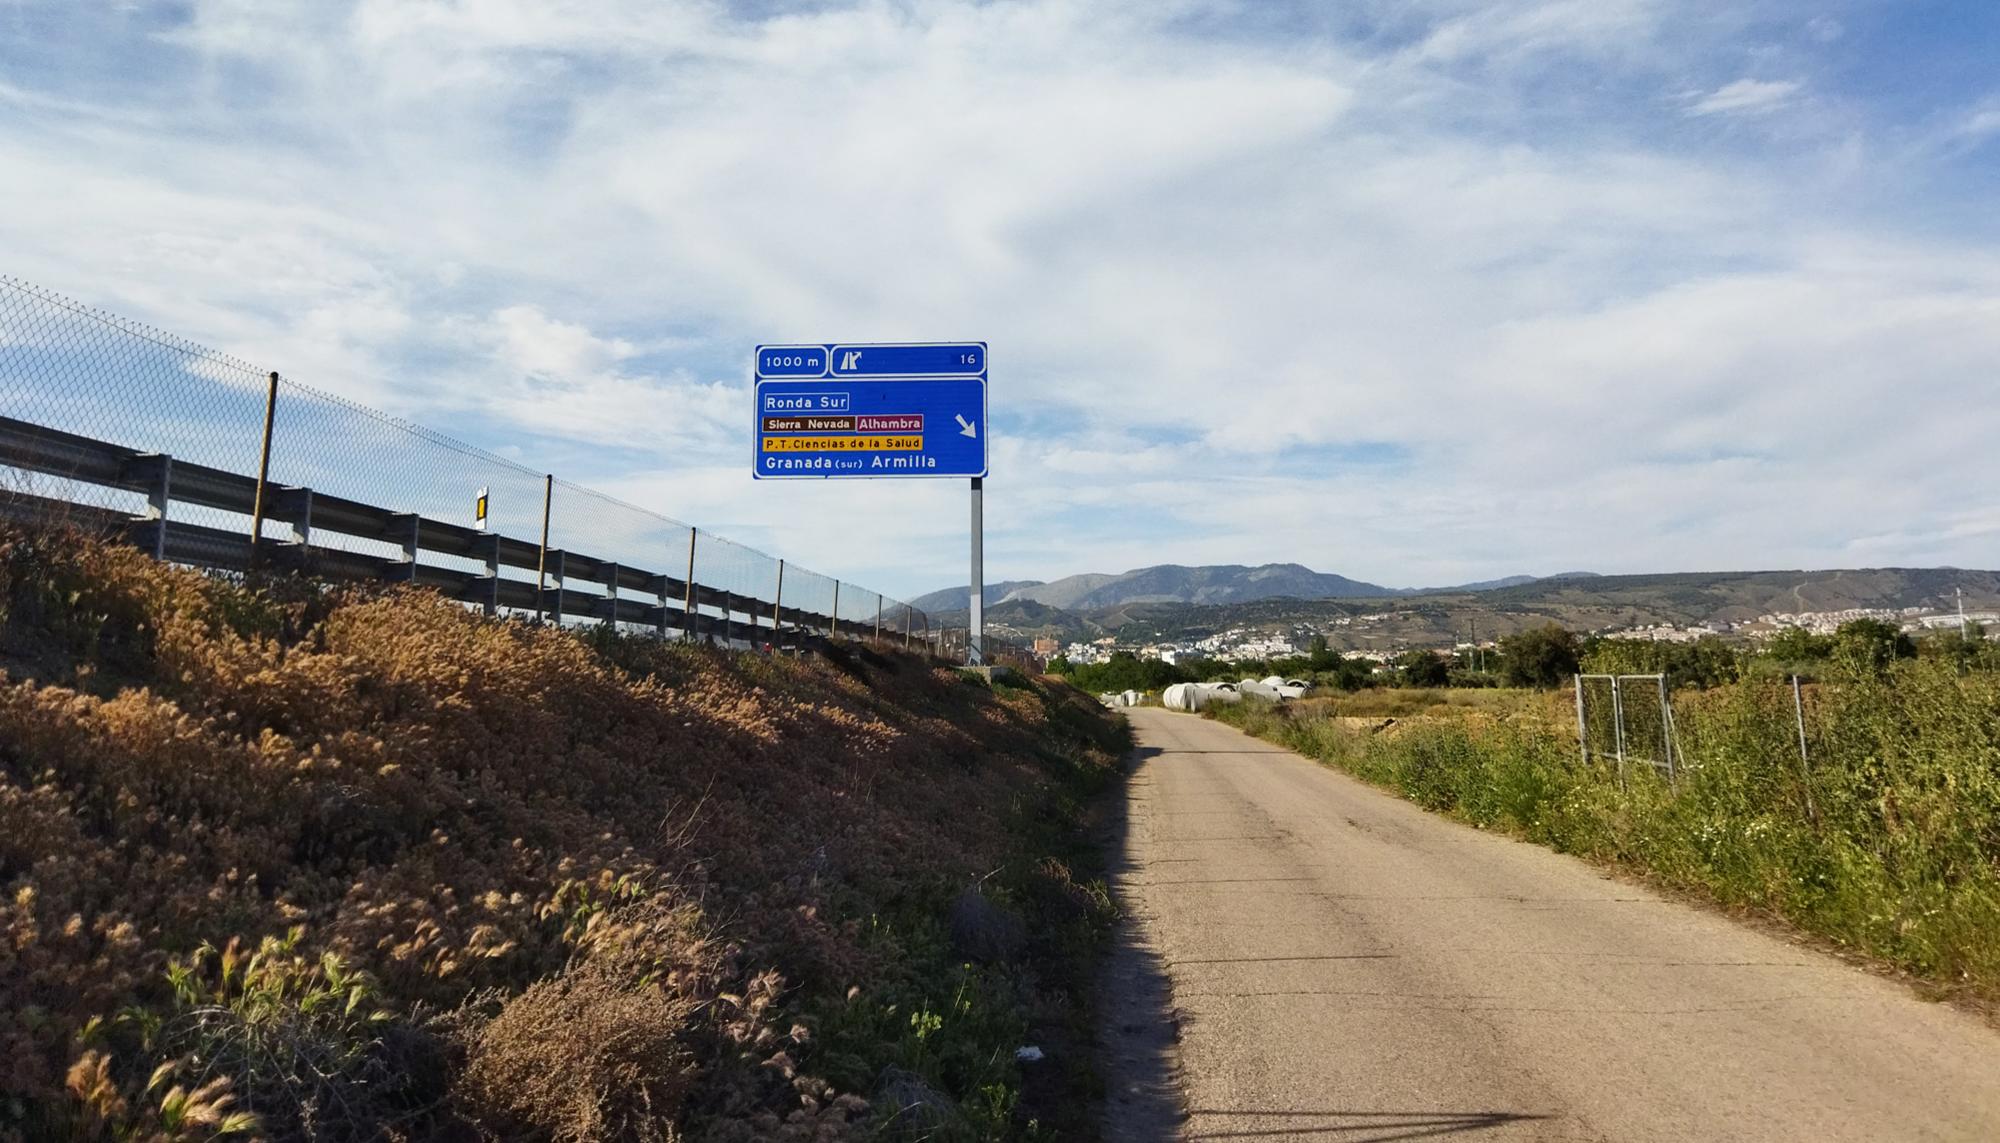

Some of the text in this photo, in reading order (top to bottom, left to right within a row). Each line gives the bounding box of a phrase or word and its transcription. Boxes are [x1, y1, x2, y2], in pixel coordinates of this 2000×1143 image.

[766, 357, 819, 367] 1000 m
[960, 354, 976, 364] 16
[766, 397, 846, 409] Ronda Sur
[768, 419, 850, 429] Sierra Nevada
[859, 418, 921, 429] Alhambra
[850, 439, 864, 448] de
[869, 439, 880, 448] la
[886, 439, 920, 448] Salud
[766, 455, 936, 469] Granada (sur) Armilla
